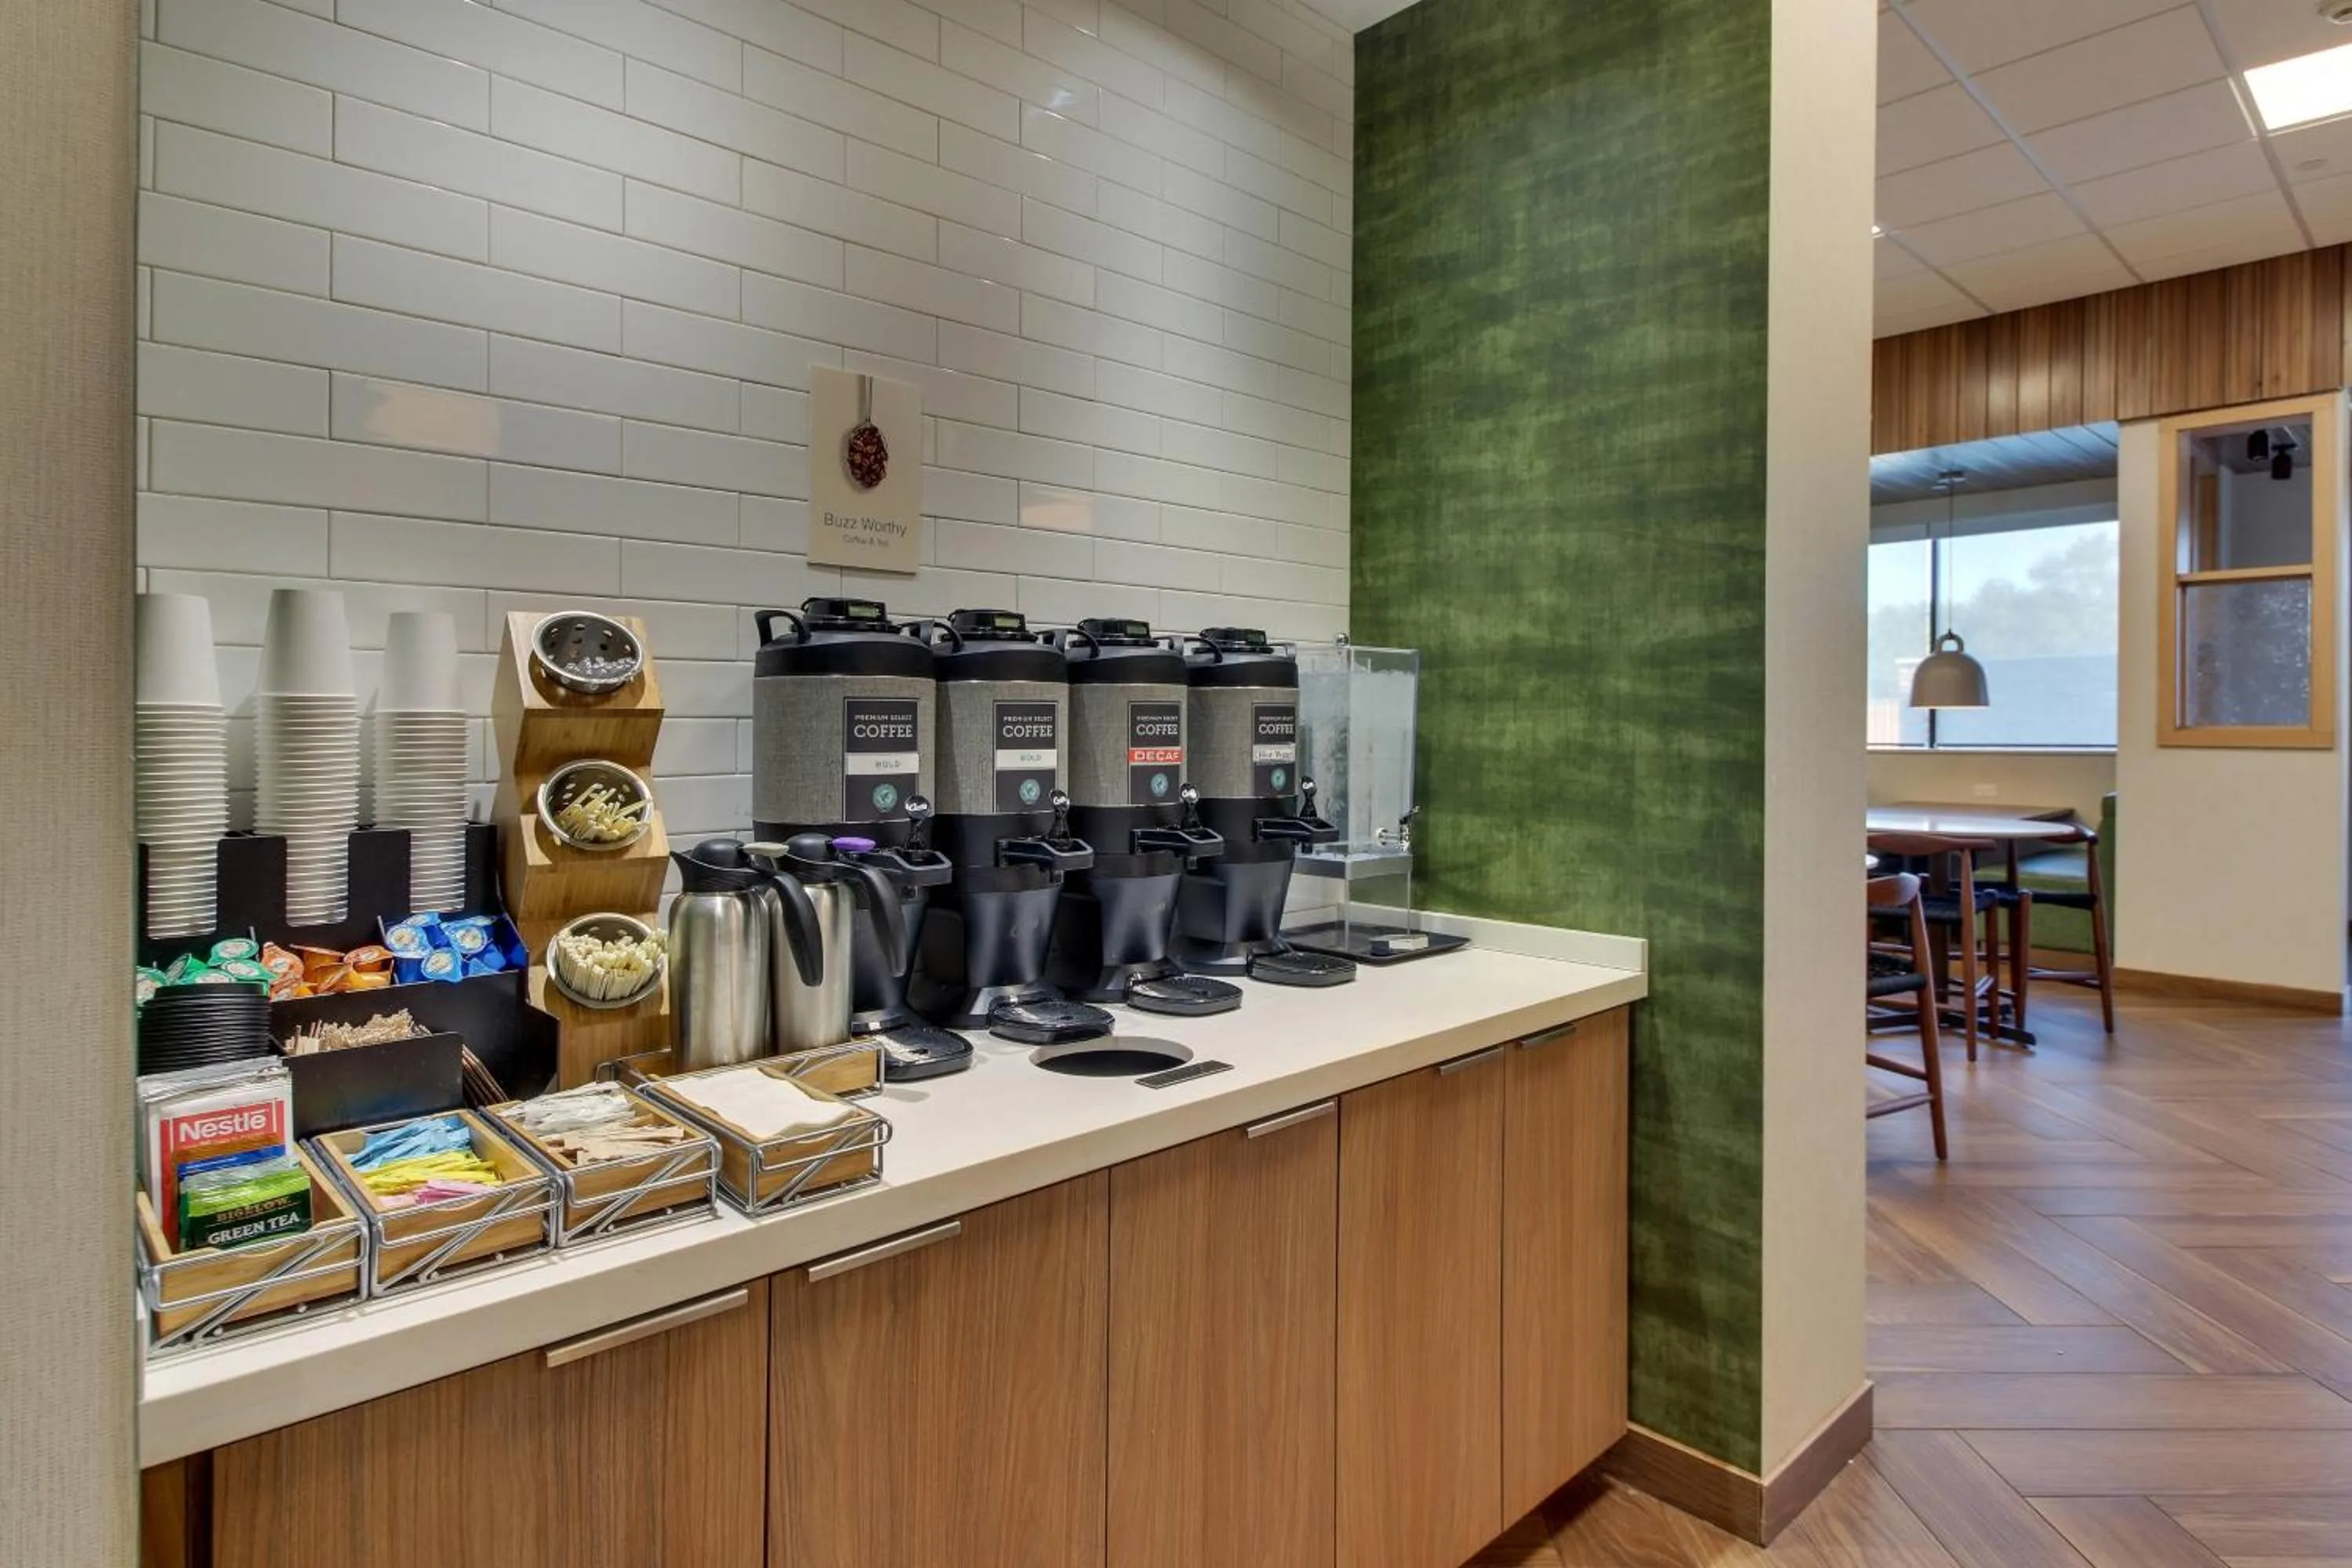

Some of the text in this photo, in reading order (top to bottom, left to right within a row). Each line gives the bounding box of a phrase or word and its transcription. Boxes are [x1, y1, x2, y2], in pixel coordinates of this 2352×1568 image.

[824, 512, 907, 537] Buzz Worthy
[854, 724, 913, 739] COFFEE
[1004, 724, 1053, 738] COFFEE
[1136, 723, 1178, 735] COFFEE
[1258, 723, 1294, 735] COFFEE
[1134, 750, 1180, 761] DECAF
[207, 1211, 300, 1244] GREEN TEA
